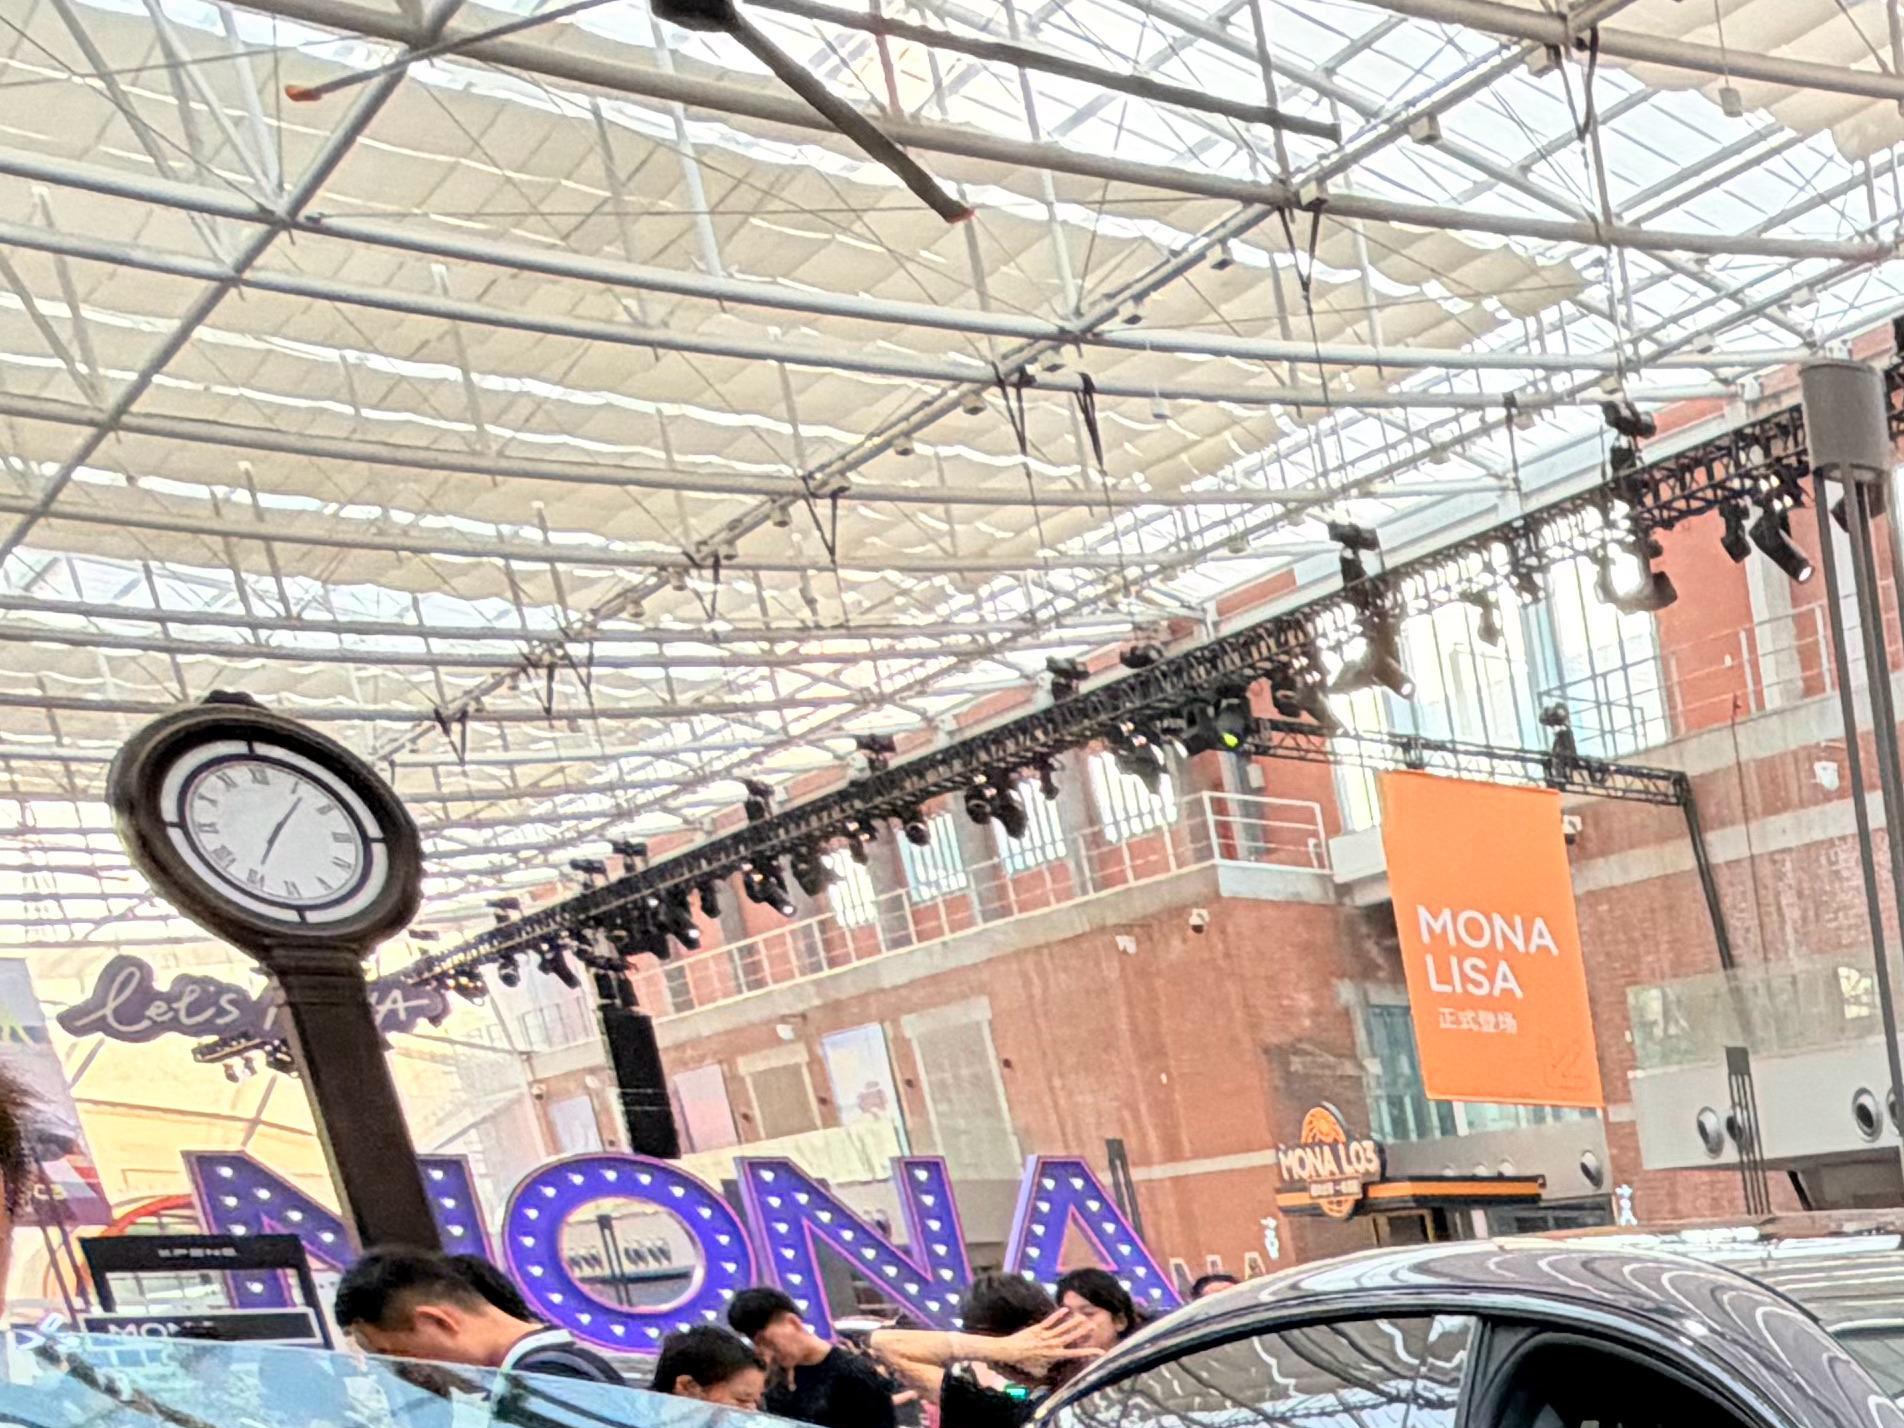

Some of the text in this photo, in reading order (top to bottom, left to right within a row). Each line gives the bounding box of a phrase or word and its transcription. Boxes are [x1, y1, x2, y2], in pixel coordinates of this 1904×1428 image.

[1416, 904, 1560, 957] MONA
[1424, 952, 1525, 999] LISA
[1278, 1143, 1340, 1182] MONA
